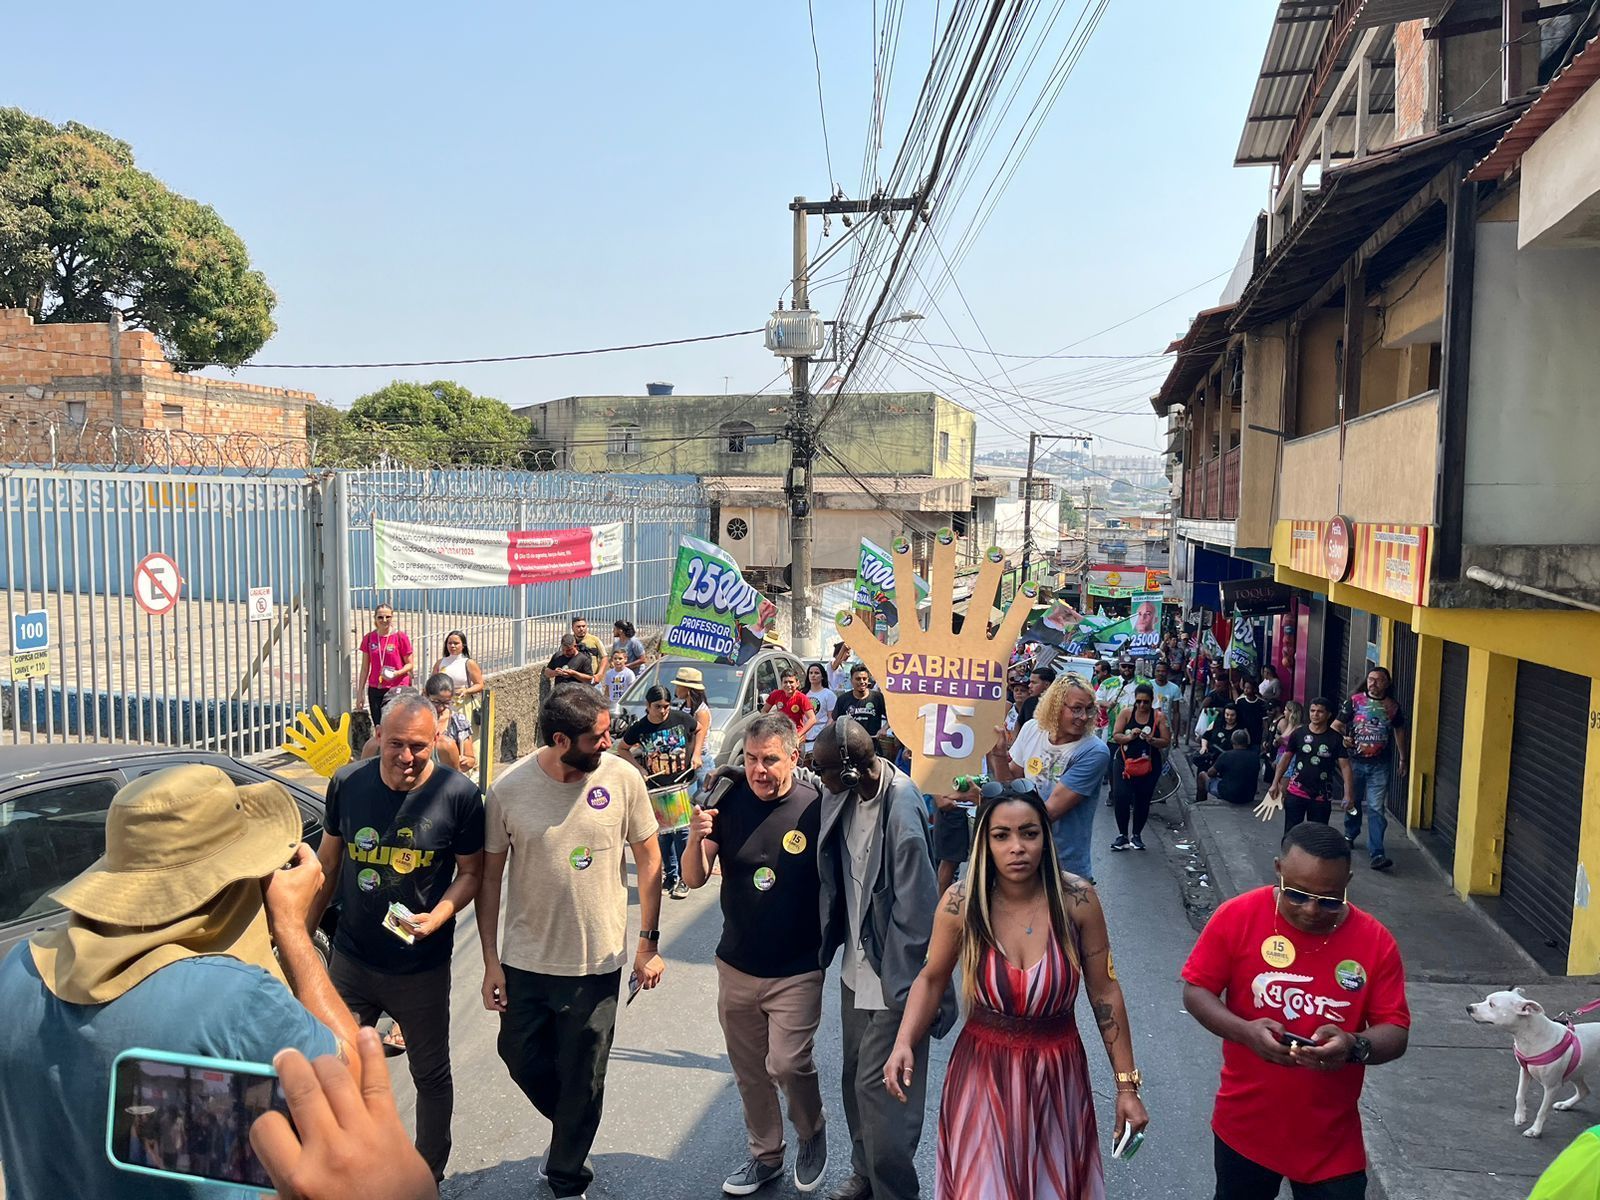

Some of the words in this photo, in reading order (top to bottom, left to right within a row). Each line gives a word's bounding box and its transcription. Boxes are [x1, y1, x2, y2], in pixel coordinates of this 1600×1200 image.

[1328, 539, 1344, 559] Sabor
[683, 558, 758, 616] 25000
[1234, 587, 1274, 600] TOQUE
[21, 622, 43, 640] 100
[681, 617, 730, 637] PROFESSOR
[669, 628, 732, 654] GIVANILDO
[1130, 633, 1160, 647] 25000
[887, 653, 1003, 683] GABRIEL
[886, 677, 1002, 699] PREFEITO
[917, 703, 975, 759] 15
[592, 789, 603, 798] 15
[793, 834, 802, 844] 15
[348, 842, 435, 868] HUK
[402, 852, 412, 862] 15
[1265, 950, 1289, 960] GABRIEL
[1272, 940, 1285, 952] 15
